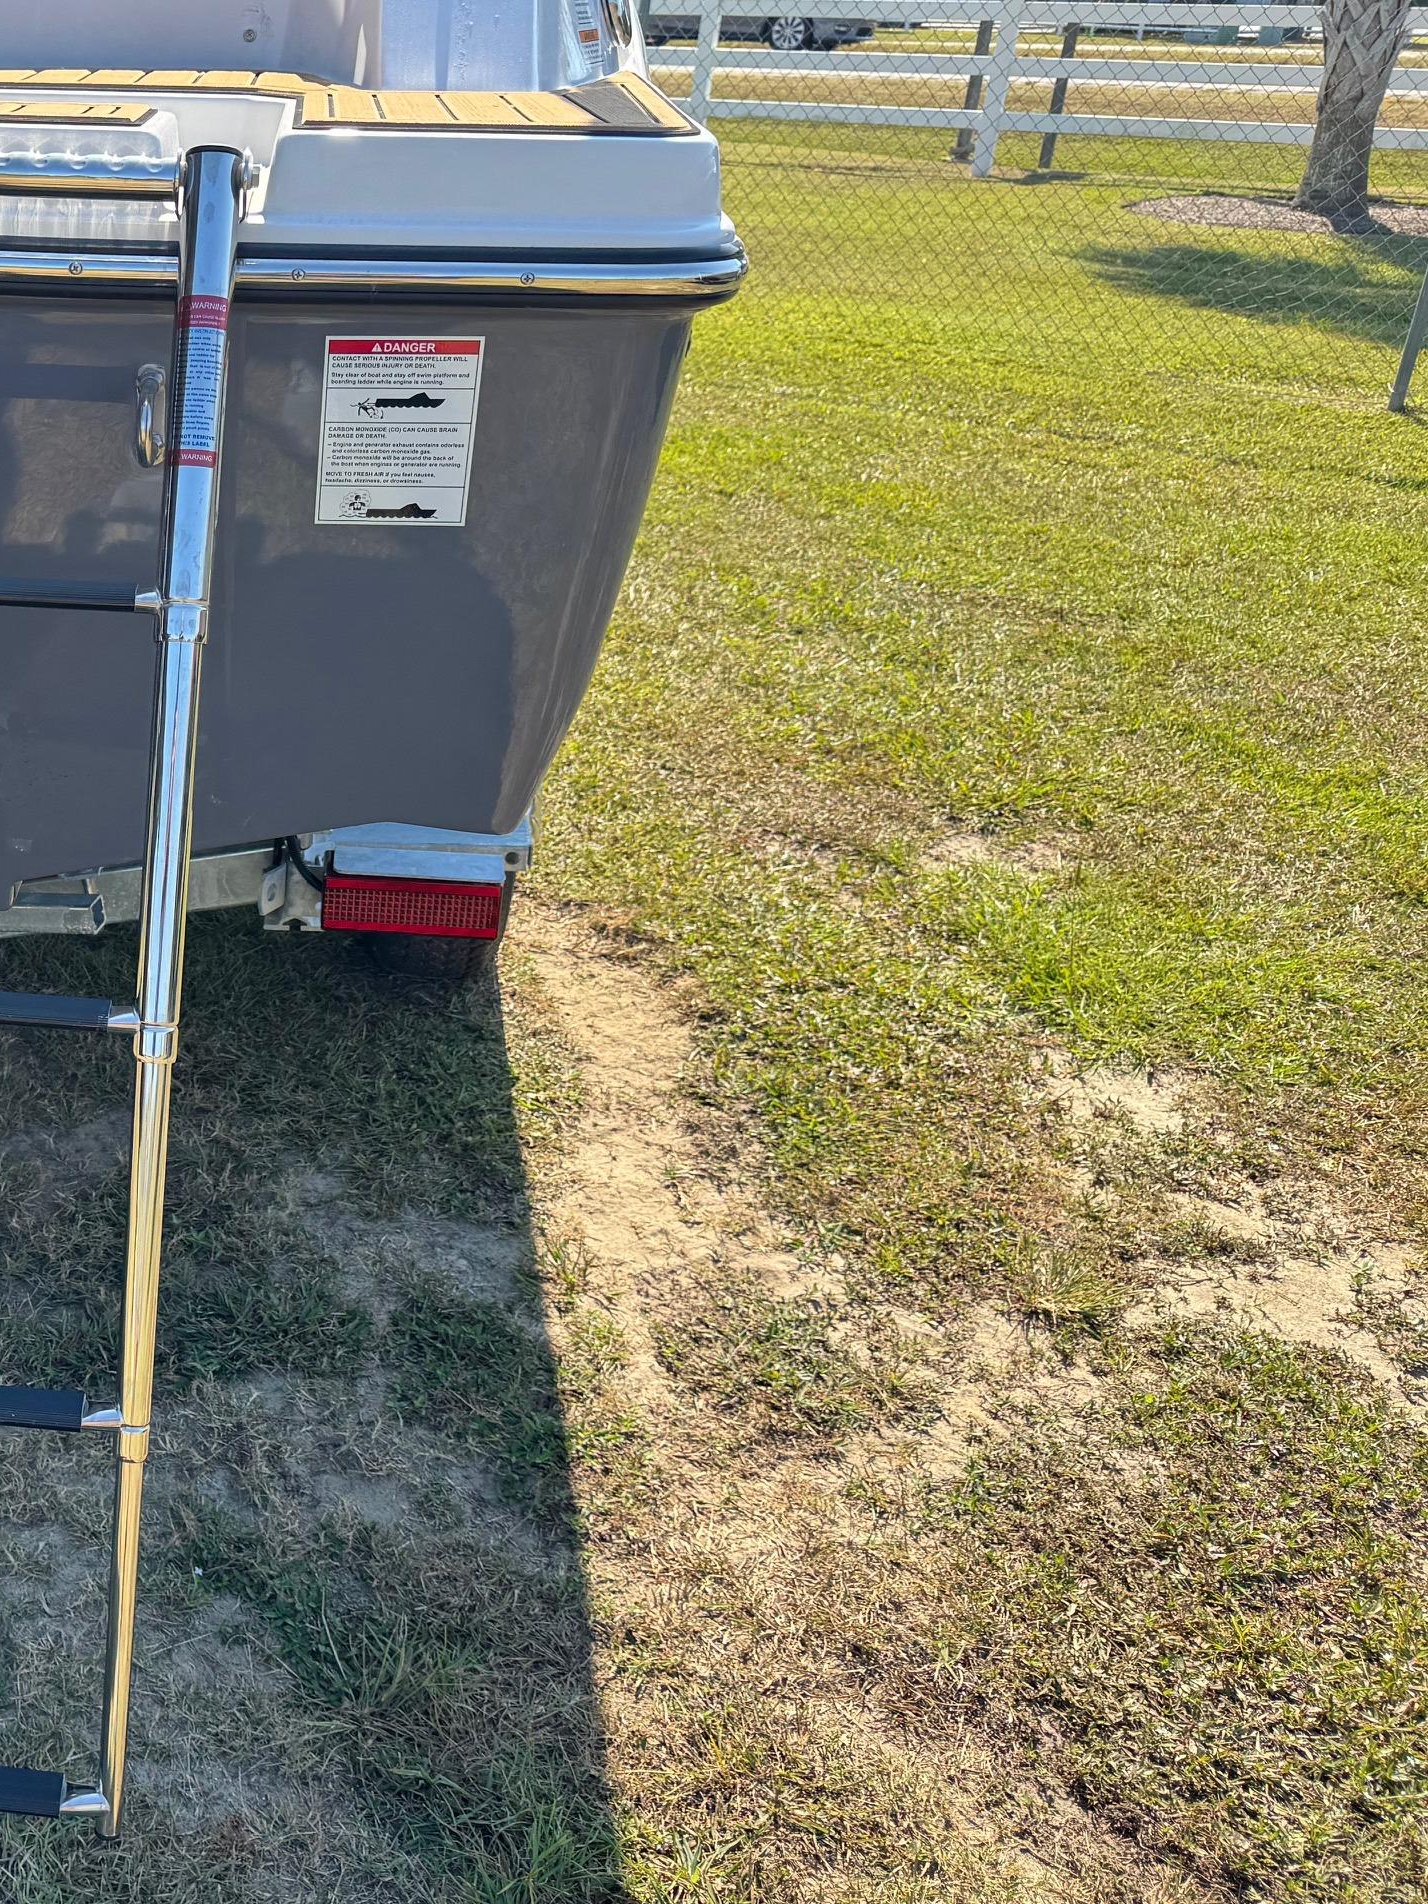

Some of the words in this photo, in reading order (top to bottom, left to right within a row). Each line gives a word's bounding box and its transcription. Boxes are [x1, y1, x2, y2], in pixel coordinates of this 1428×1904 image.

[191, 302, 227, 312] WARNING
[384, 342, 435, 353] DANGER
[181, 454, 213, 462] WARNING
